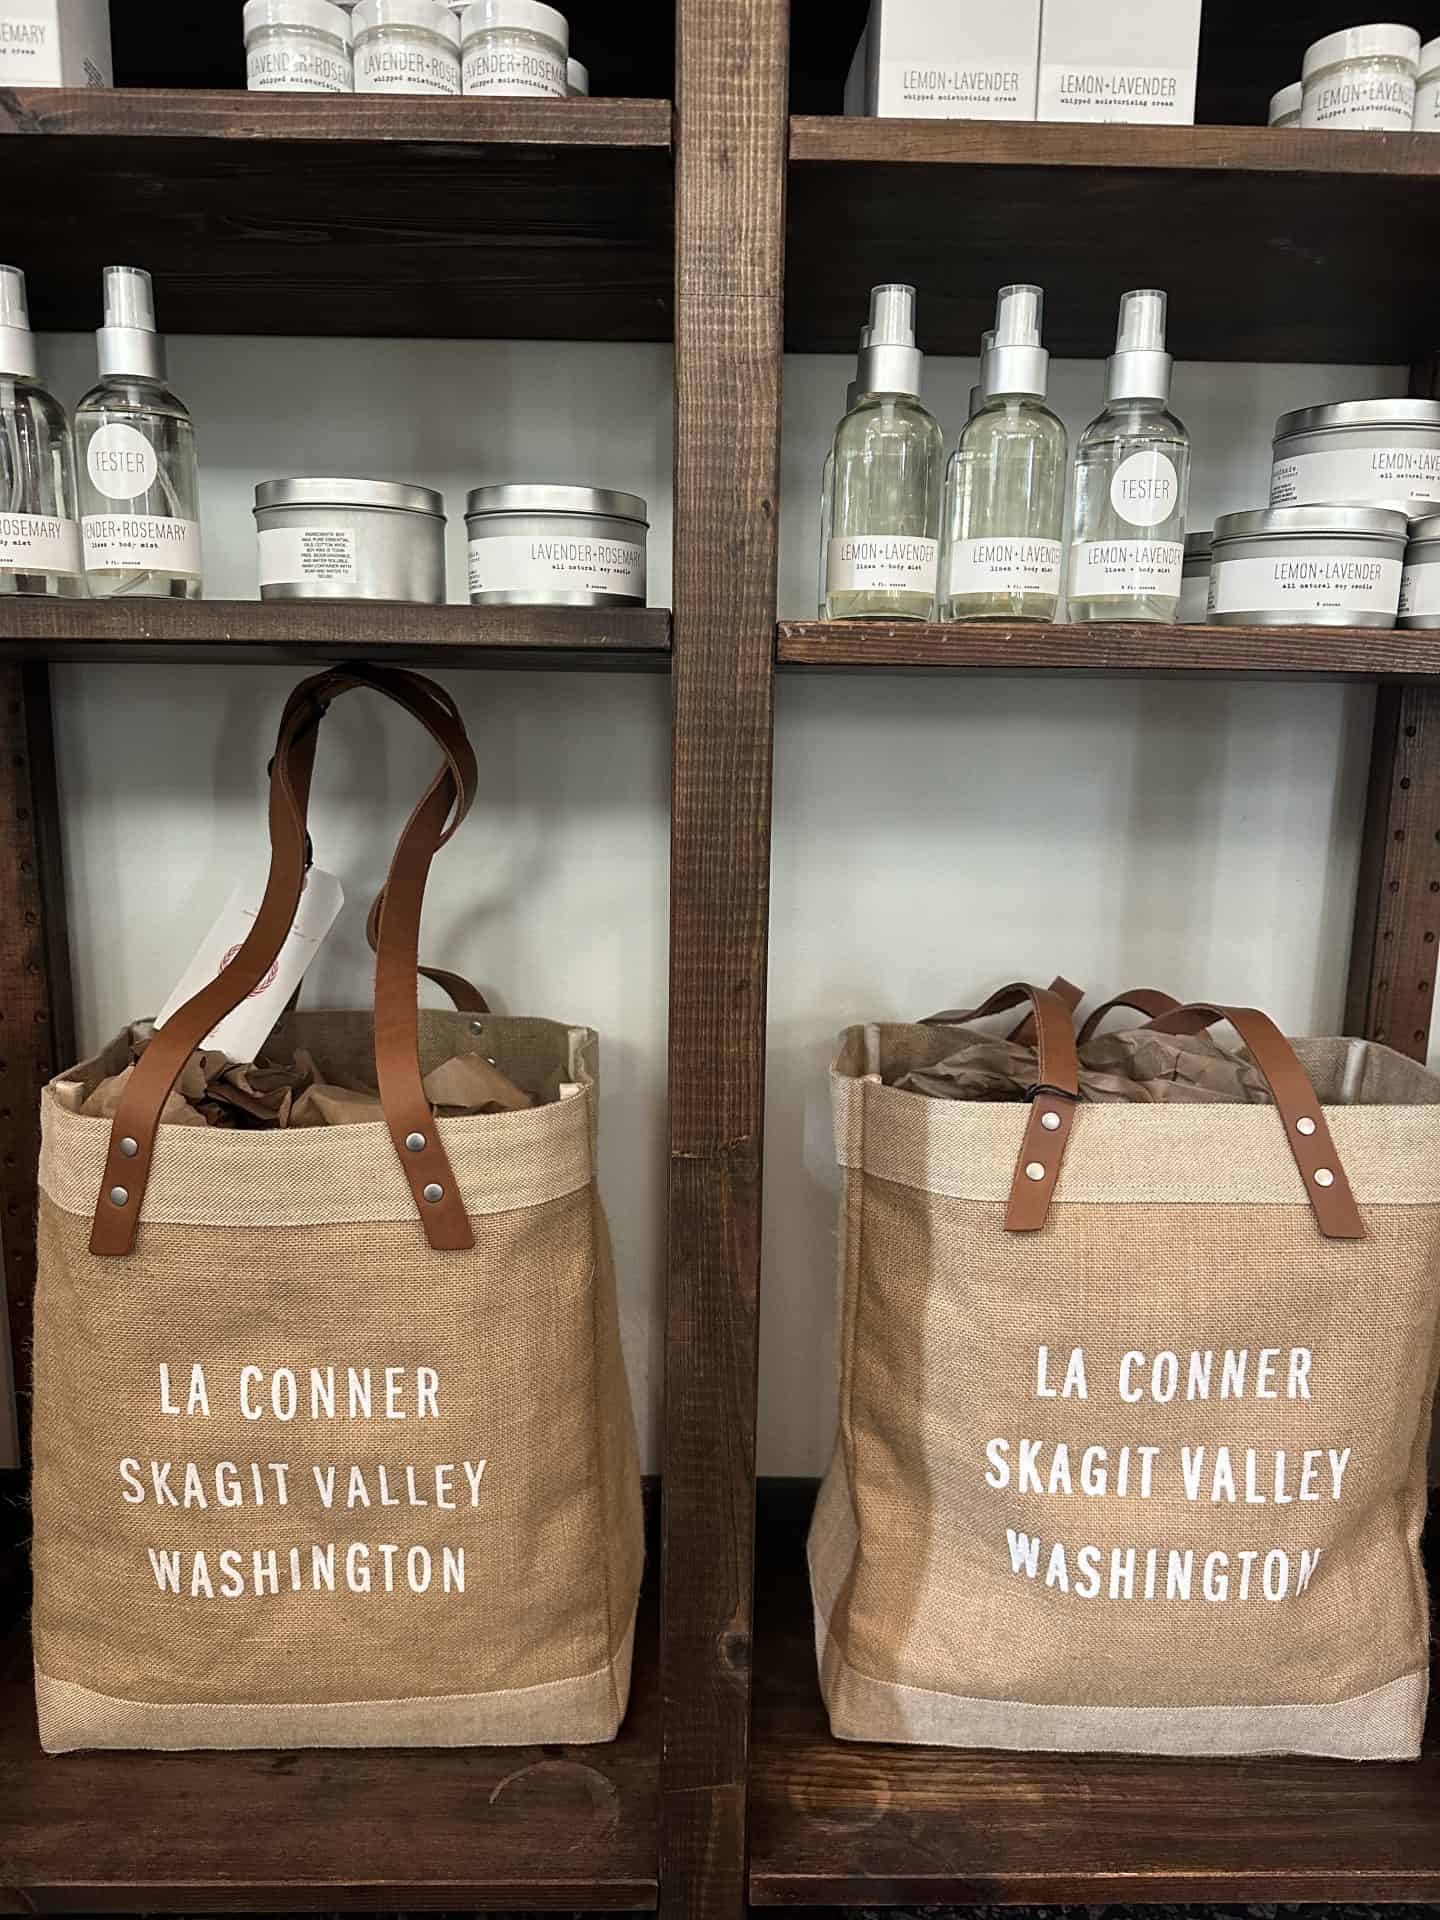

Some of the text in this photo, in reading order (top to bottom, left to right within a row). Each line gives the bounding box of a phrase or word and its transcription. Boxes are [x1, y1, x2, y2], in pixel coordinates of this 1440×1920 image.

[95, 450, 146, 474] TESTER
[1121, 479, 1170, 500] TESTER
[159, 1362, 440, 1422] LA CONNER
[1036, 1344, 1314, 1404] LA CONNER
[119, 1458, 488, 1510] SKAGIT VALLEY
[984, 1437, 1352, 1504] SKAGIT VALLEY
[147, 1542, 466, 1599] WASHINGTON
[1006, 1527, 1325, 1602] WASHINGTON
